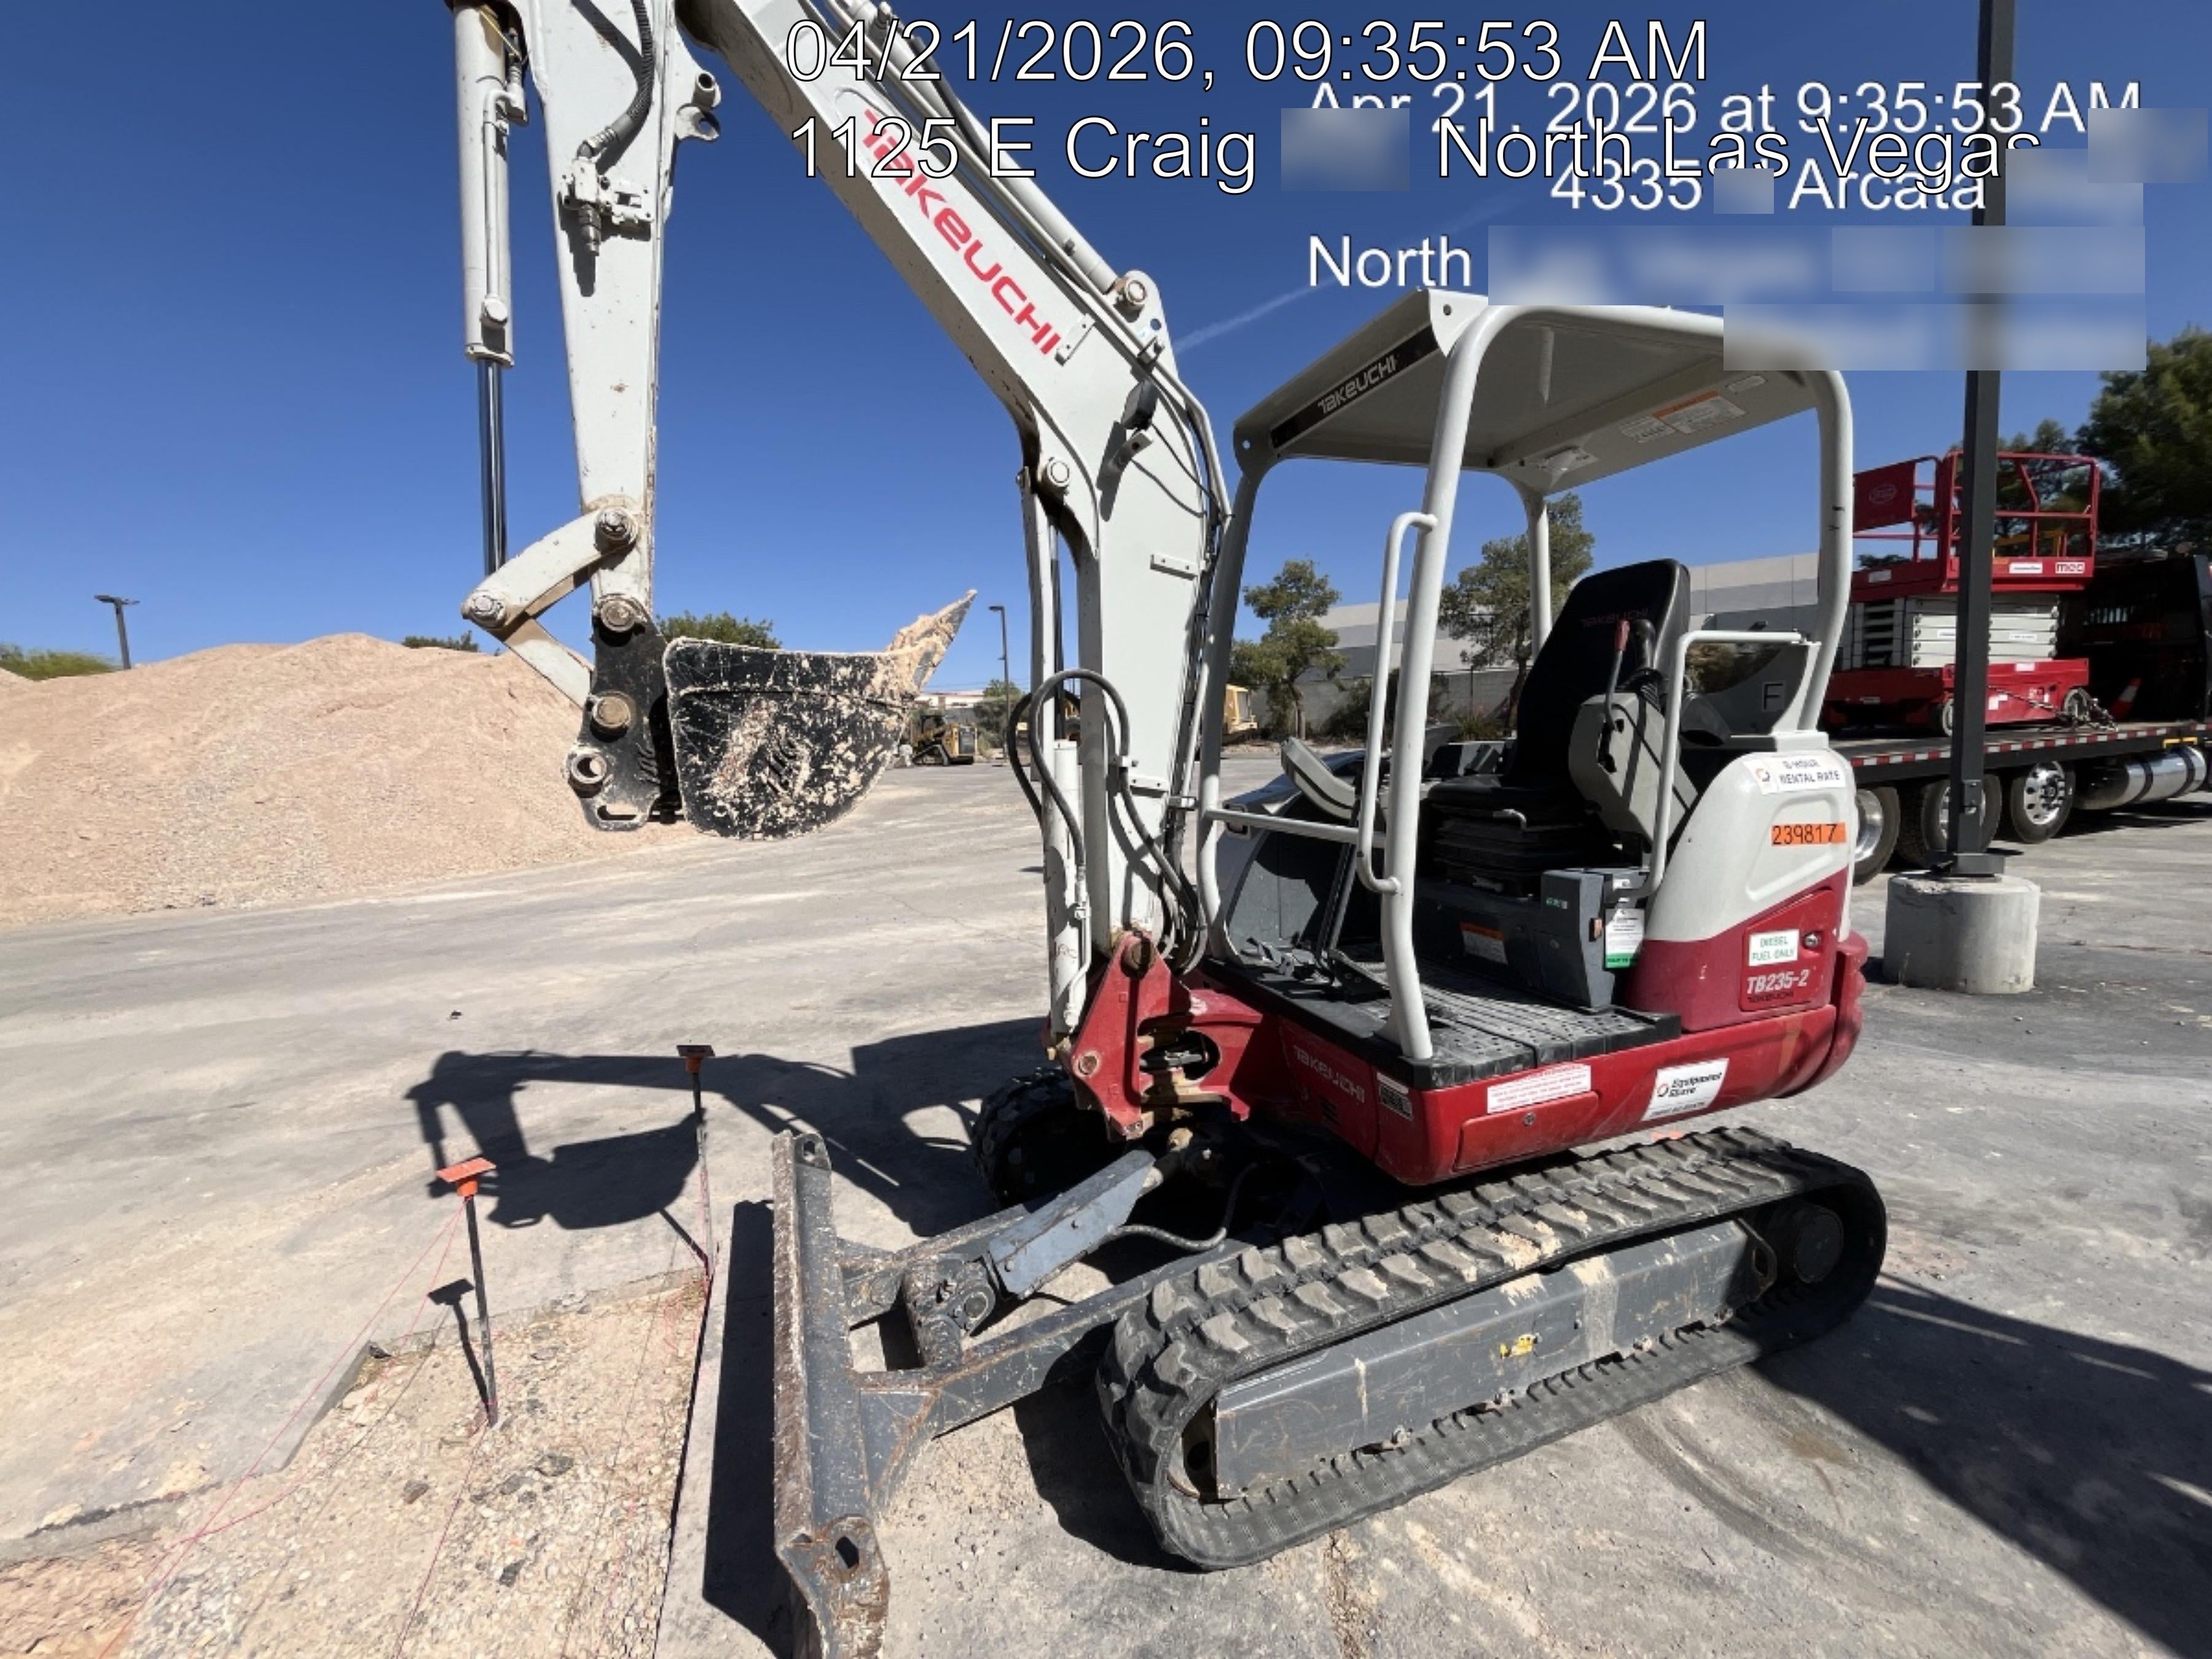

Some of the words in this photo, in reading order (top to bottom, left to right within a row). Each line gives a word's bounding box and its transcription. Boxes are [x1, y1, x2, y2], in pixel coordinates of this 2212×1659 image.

[1764, 683, 1783, 710] F
[1772, 823, 1837, 845] 239817
[1752, 951, 1771, 961] FUEL
[1747, 969, 1810, 994] TB235-2
